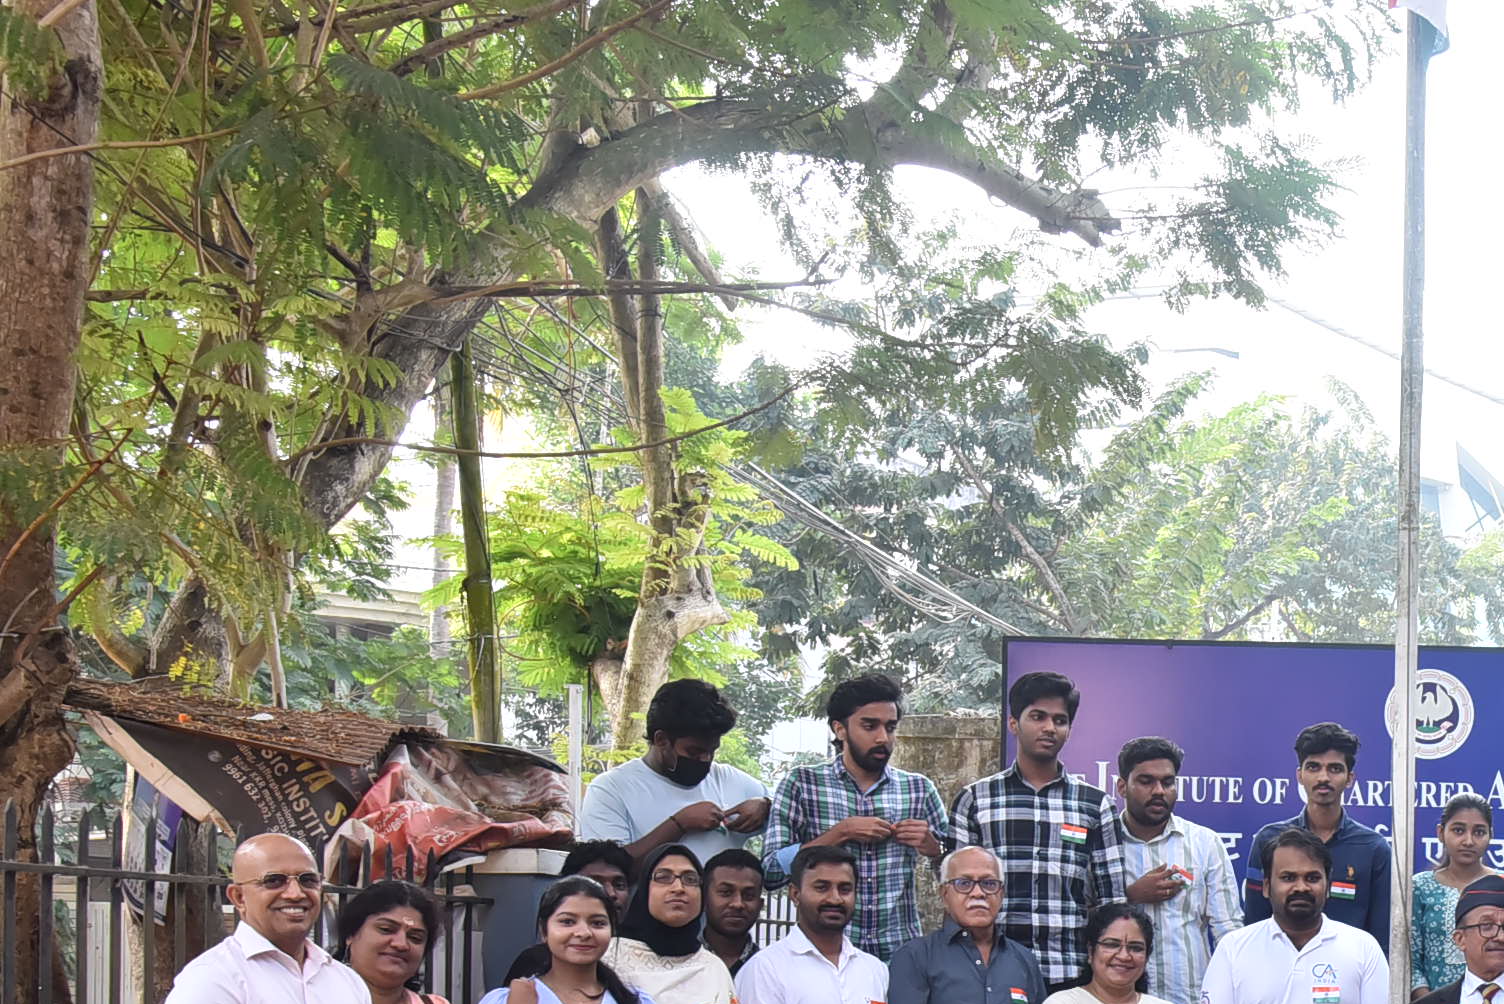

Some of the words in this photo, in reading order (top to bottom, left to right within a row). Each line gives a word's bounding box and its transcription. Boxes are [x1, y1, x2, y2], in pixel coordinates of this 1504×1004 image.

[261, 748, 289, 777] SIC
[222, 763, 247, 783] 9961
[244, 783, 261, 801] 632
[1252, 777, 1290, 804] OF
